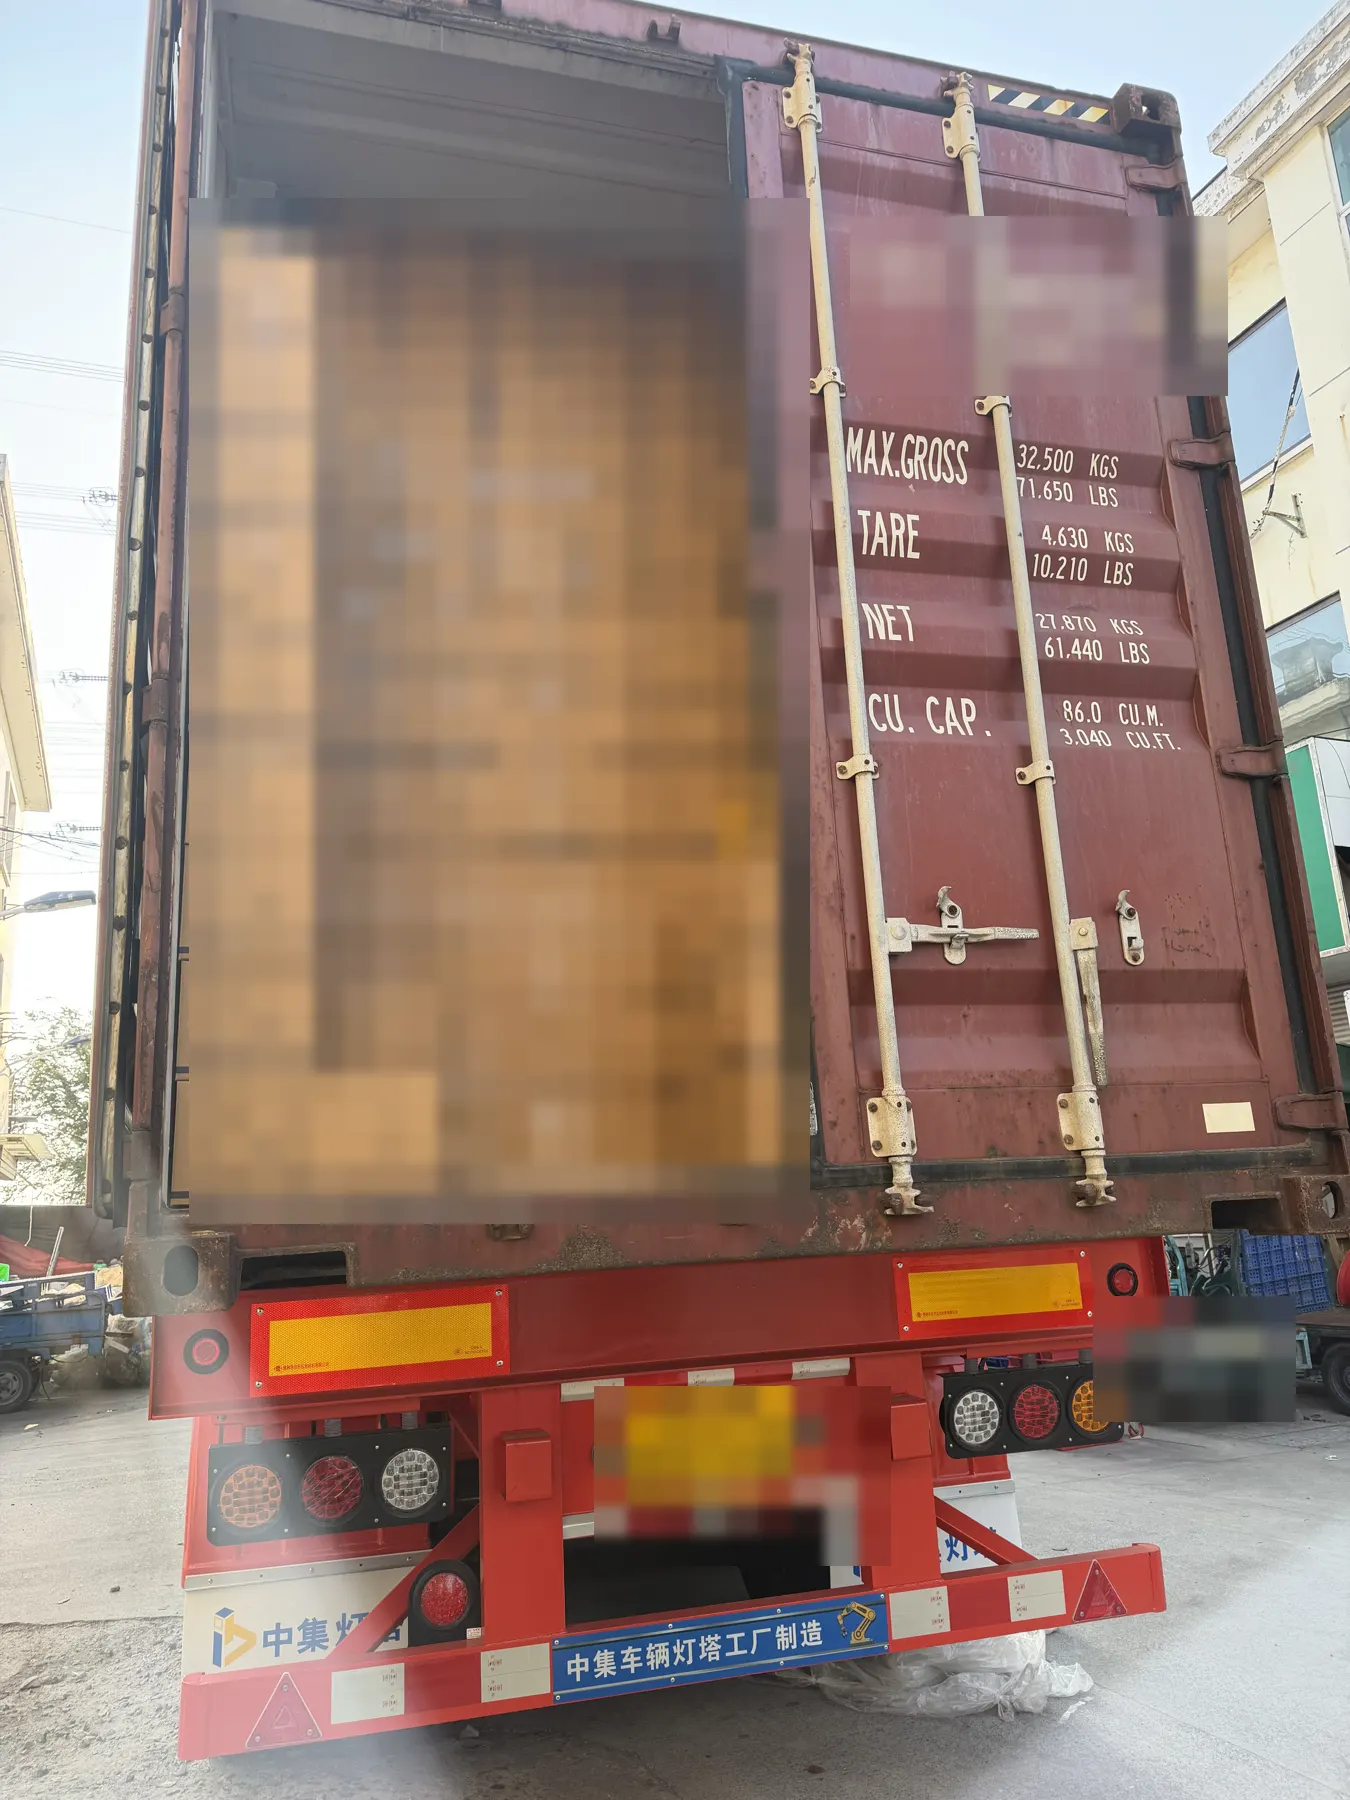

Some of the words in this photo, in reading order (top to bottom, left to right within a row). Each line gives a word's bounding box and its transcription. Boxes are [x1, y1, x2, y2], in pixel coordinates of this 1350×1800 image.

[846, 426, 969, 485] MAX.GROSS
[1017, 444, 1073, 473] 32,500
[1089, 453, 1119, 479] KGS
[1088, 485, 1119, 507] LBS
[857, 509, 920, 559] TARE
[1041, 524, 1088, 549] 4,630
[1104, 531, 1135, 554] KGS
[1033, 553, 1088, 581] 10,210
[1103, 560, 1134, 586] LBS
[861, 602, 914, 642] NET
[1109, 618, 1144, 636] KGS
[1044, 636, 1103, 661] 61,440
[1119, 641, 1150, 664] LBS
[868, 693, 915, 733] CU.
[1063, 700, 1102, 723] 86.0
[1118, 703, 1164, 727] CU.M.
[1125, 731, 1182, 750] CU.FT.
[567, 1619, 823, 1682] 中集车辆灯塔工厂制造
